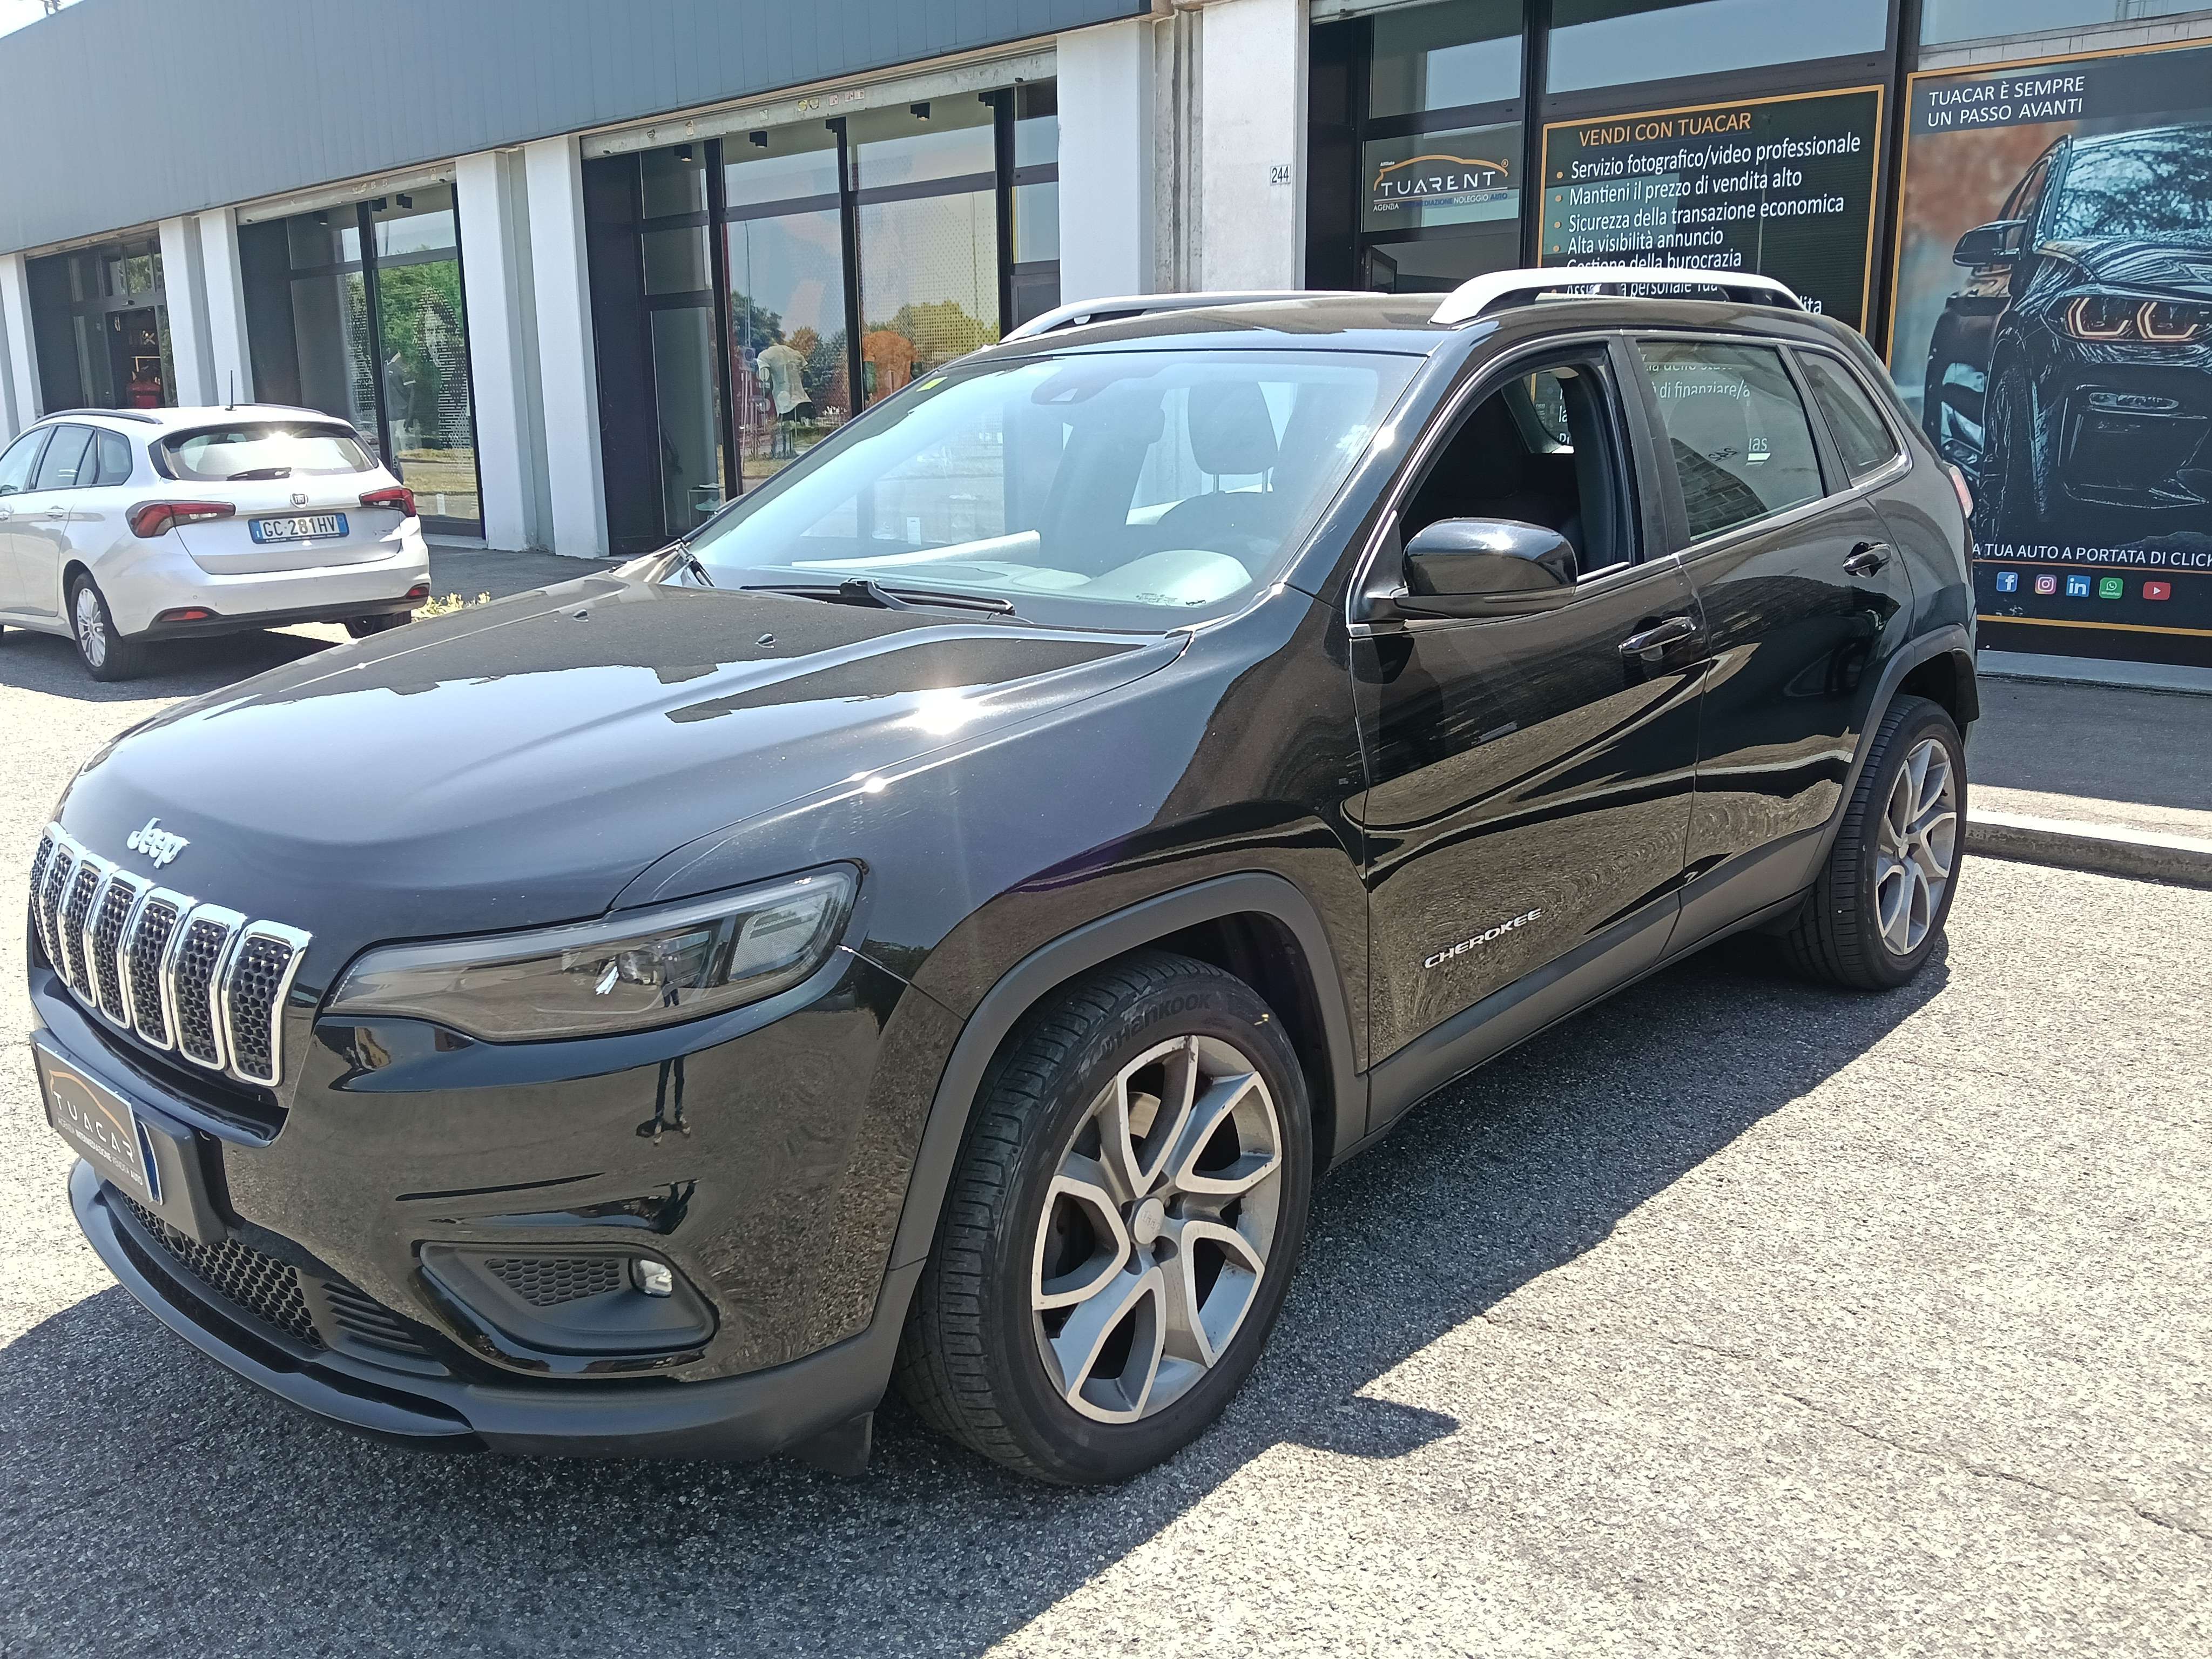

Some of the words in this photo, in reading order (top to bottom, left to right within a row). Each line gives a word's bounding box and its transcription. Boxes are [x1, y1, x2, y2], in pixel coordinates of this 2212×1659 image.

[1928, 85, 1994, 106] TUACAR
[2000, 80, 2009, 99] È
[2013, 76, 2086, 98] SEMPRE
[1927, 111, 1952, 127] UN
[1959, 105, 2012, 124] PASSO
[2018, 97, 2083, 119] AVANTI
[1579, 125, 1630, 147] VENDI
[1635, 121, 1673, 141] CON
[1677, 112, 1751, 136] TUACAR
[1571, 157, 1623, 179] Servizio
[1627, 143, 1751, 176] fotografico/video
[1756, 131, 1861, 166] professionale
[1271, 165, 1289, 184] 244
[1380, 171, 1495, 197] TUARENT
[1569, 183, 1630, 206] Mantieni
[1634, 181, 1642, 200] il
[1645, 181, 1691, 204] prezzo
[1695, 174, 1709, 195] di
[1712, 171, 1768, 193] vendita
[1772, 166, 1802, 187] alto
[1373, 203, 1399, 212] AGENZIA
[1453, 193, 1489, 204] NOLEGGIO
[1489, 192, 1508, 200] AUTO
[1568, 213, 1629, 233] Sicurezza
[1634, 207, 1667, 227] della
[1671, 201, 1756, 225] transazione
[1760, 193, 1844, 218] economica
[1567, 235, 1594, 255] Alta
[1597, 230, 1653, 253] visibilità
[1657, 226, 1724, 248] annuncio
[1630, 253, 1663, 268] della
[1667, 249, 1742, 269] burocrazia
[1660, 381, 1671, 399] di
[263, 521, 284, 538] GC
[1985, 543, 2014, 557] TUA
[2017, 545, 2059, 559] AUTO
[2061, 549, 2072, 559] A
[2076, 547, 2146, 564] PORTATA
[2150, 551, 2166, 565] DI
[126, 817, 191, 869] Jeep
[1424, 907, 1543, 969] CHEROKEE
[53, 1090, 134, 1163] TUACAR
